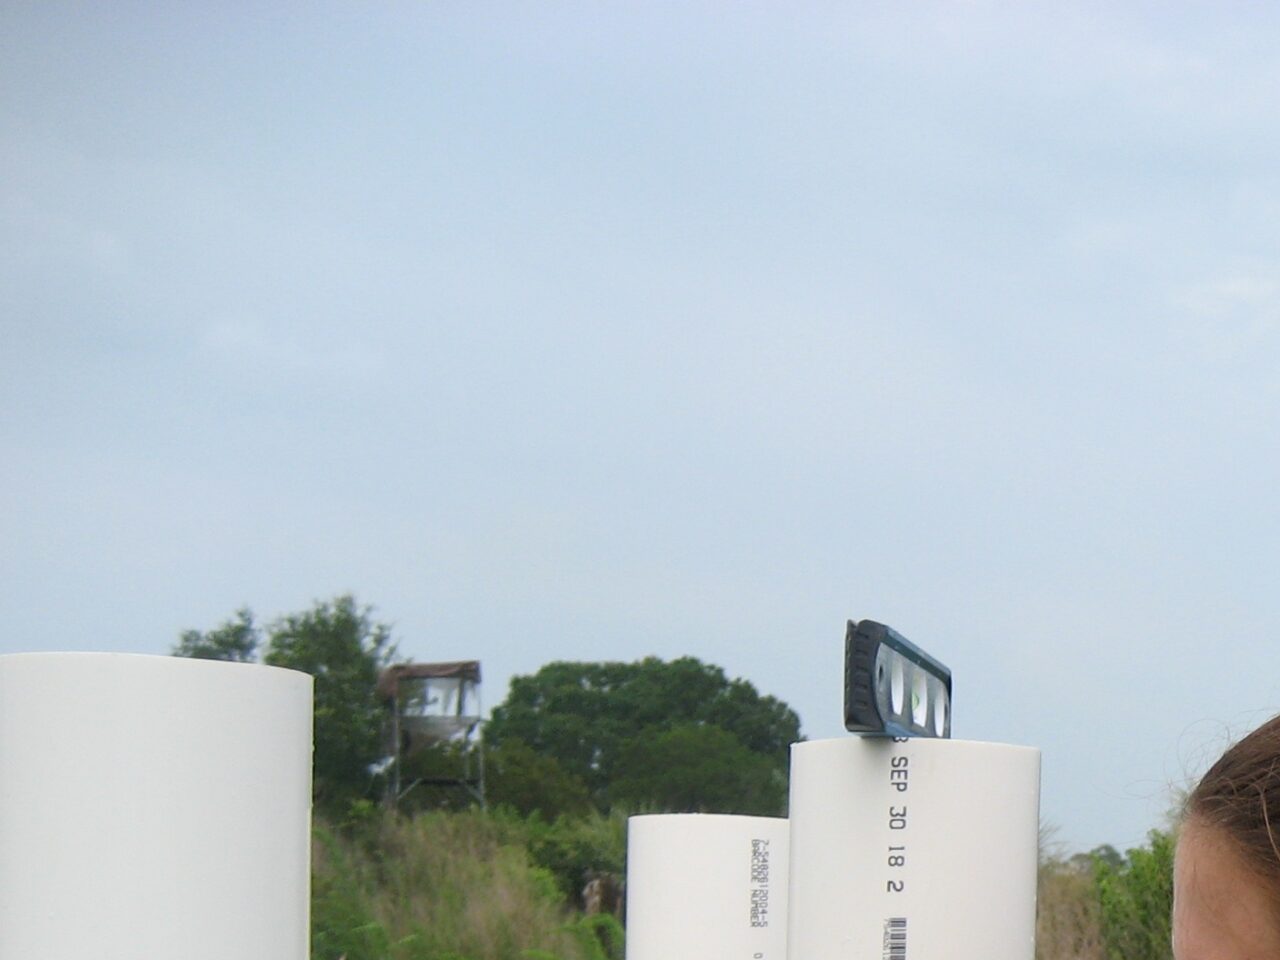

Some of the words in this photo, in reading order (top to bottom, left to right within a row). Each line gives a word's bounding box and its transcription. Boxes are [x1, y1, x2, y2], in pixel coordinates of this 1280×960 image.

[890, 756, 908, 792] SEP
[889, 806, 907, 830] 30
[751, 839, 761, 883] BARCODE
[887, 845, 905, 867] 18
[887, 879, 904, 893] 2
[750, 889, 760, 928] NUMBER
